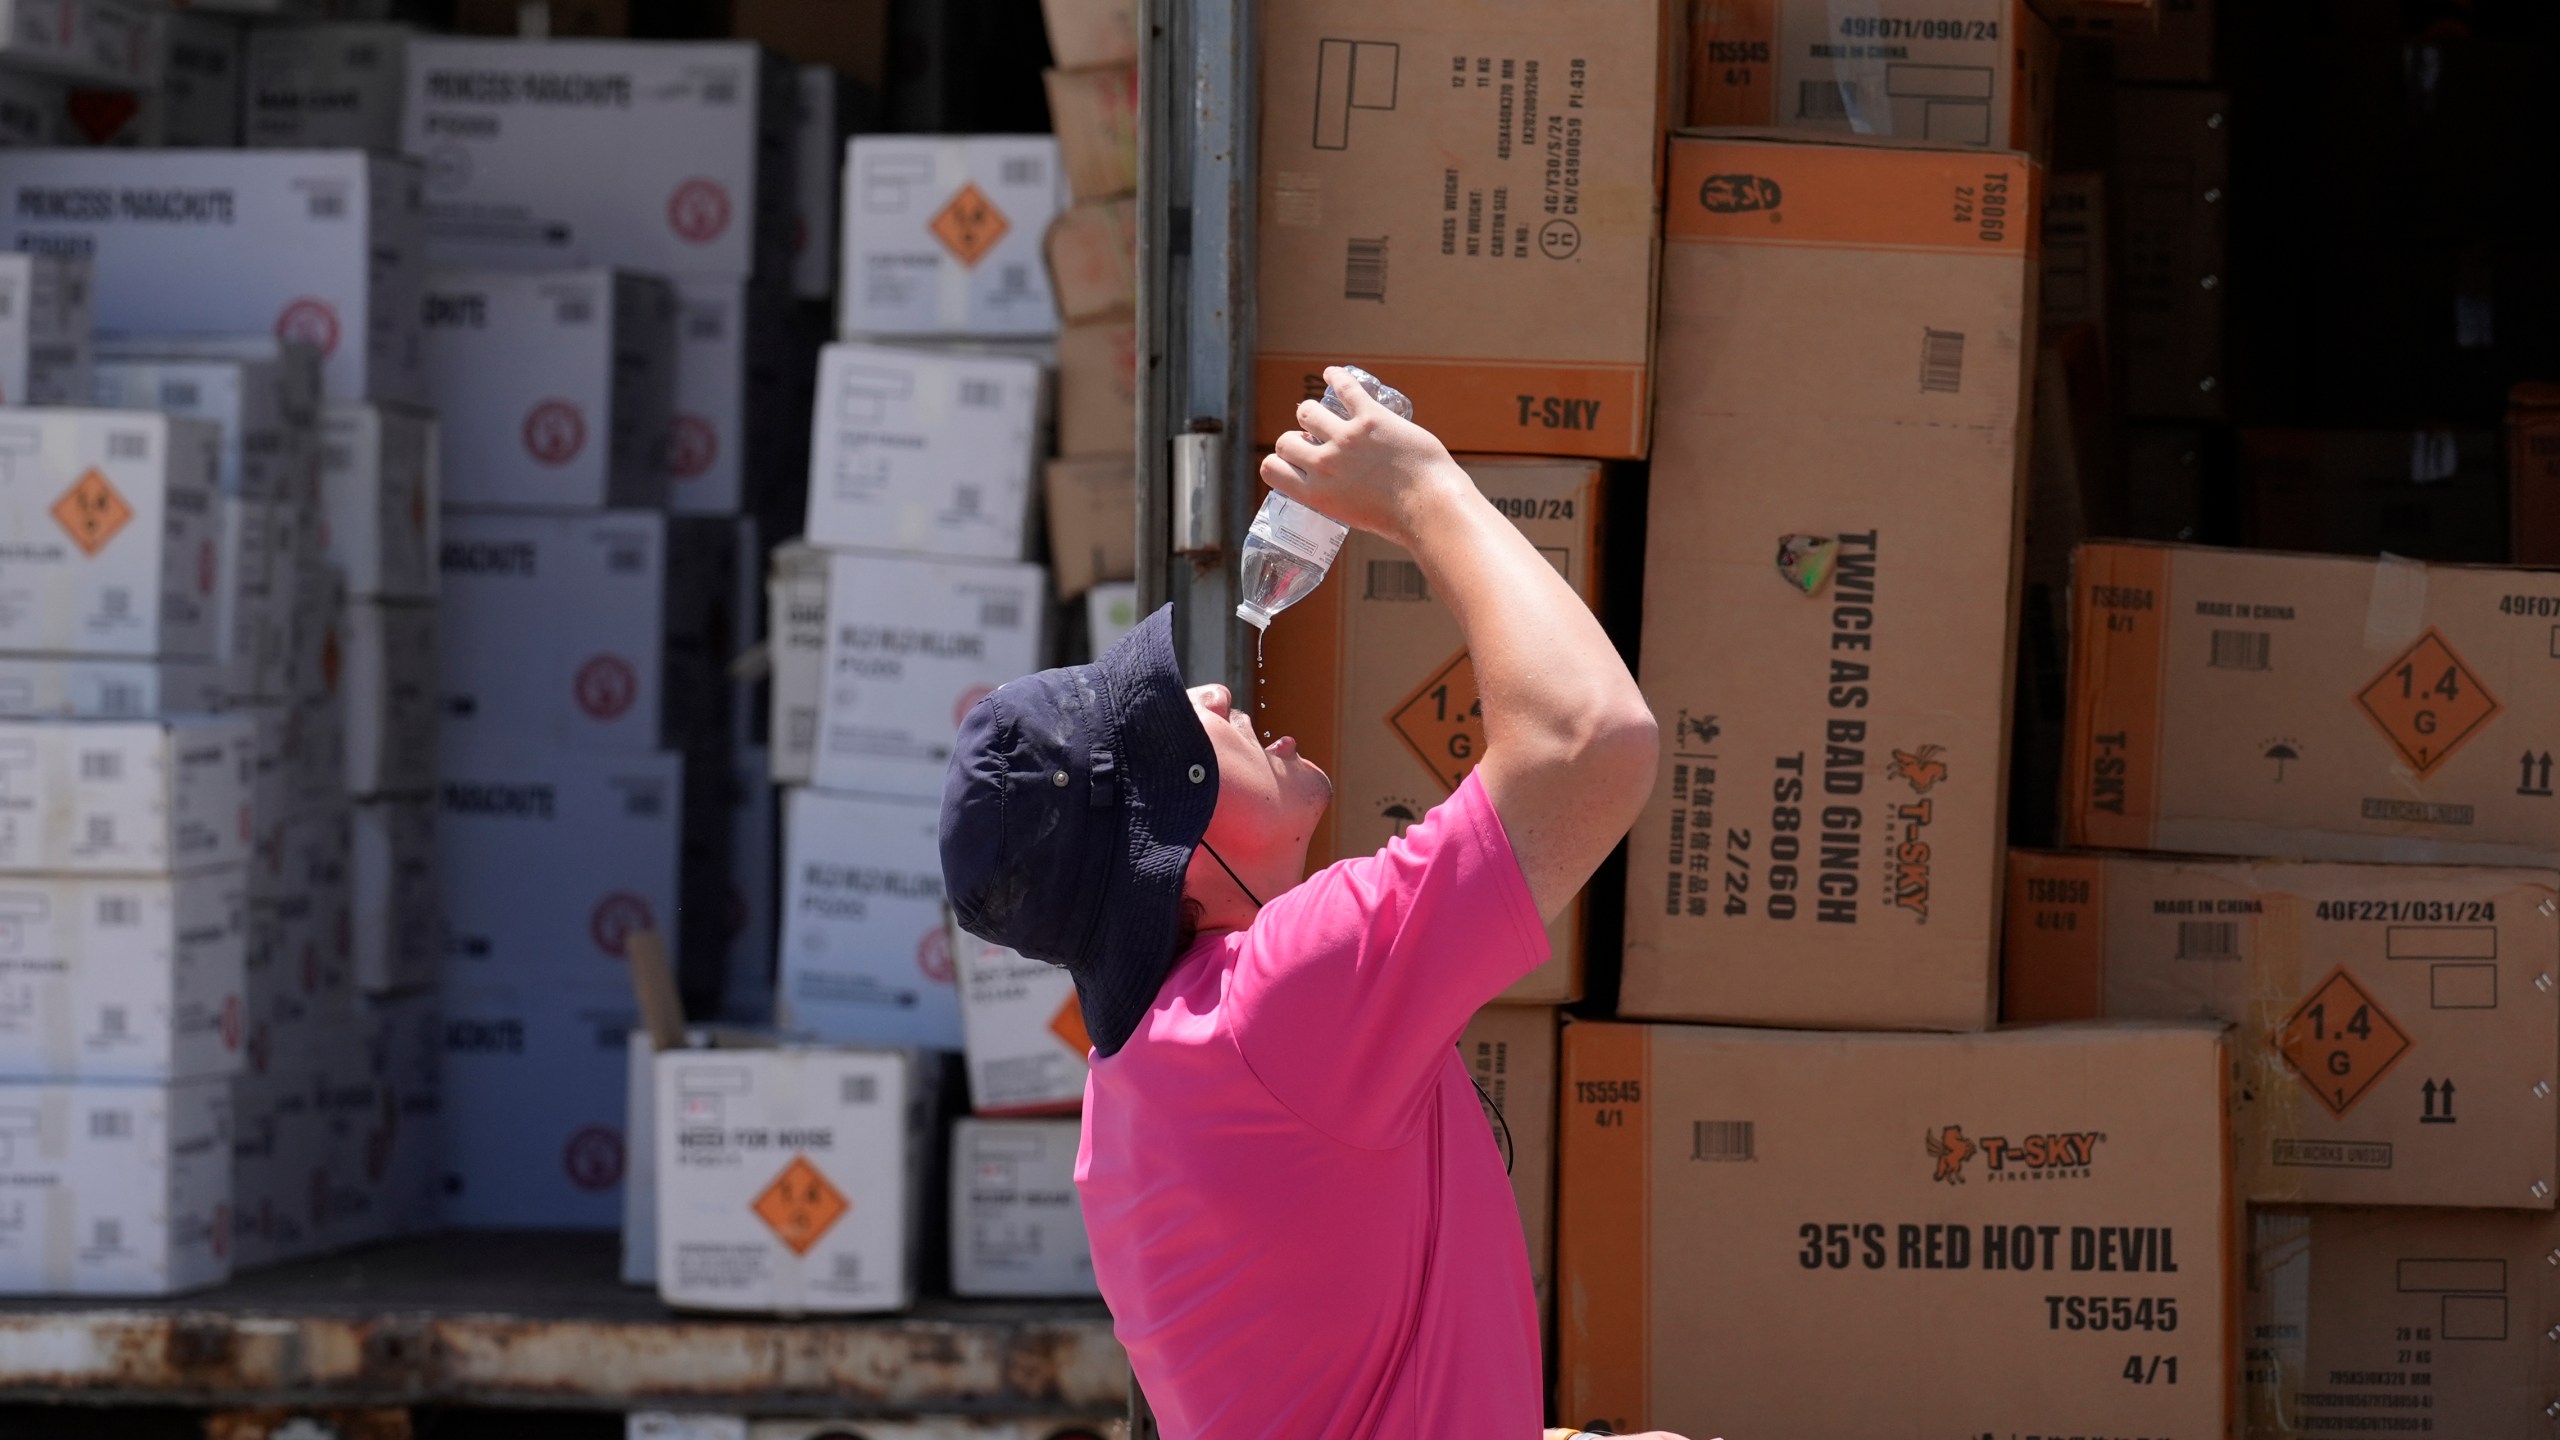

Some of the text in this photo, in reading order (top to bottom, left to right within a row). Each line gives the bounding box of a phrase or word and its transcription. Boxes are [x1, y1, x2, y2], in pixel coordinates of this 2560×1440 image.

[1709, 42, 1770, 64] TS5545
[1810, 44, 1909, 60] MADE IN CHINA
[1444, 168, 1459, 211] WEIGHT
[1953, 186, 1975, 223] 2/24
[1979, 172, 2009, 242] TS8060
[1442, 218, 1457, 255] GROSS
[1467, 236, 1480, 256] NET
[1491, 213, 1505, 258] CARTON
[1516, 395, 1601, 431] T-SKY
[2196, 601, 2296, 621] MADE IN CHINA
[2396, 663, 2459, 701] 1.4
[1817, 529, 1877, 924] TWICE AS BAD 6INCH
[2413, 710, 2436, 735] G
[1448, 733, 1471, 759] G
[2418, 747, 2430, 764] 1
[2094, 730, 2127, 815] T-SKY
[1666, 764, 1689, 917] MOST TRUSTED BRAND
[1767, 751, 1804, 921] TS8060
[1723, 827, 1752, 917] 2/24
[2154, 899, 2263, 914] MADE IN CHINA
[2316, 901, 2496, 922] 40F221/031/24
[2306, 1003, 2372, 1041] 1.4
[2327, 1050, 2351, 1077] G
[1574, 1080, 1641, 1104] TS5545
[2334, 1087, 2345, 1107] 1
[1595, 1109, 1625, 1128] 4/1
[1987, 1167, 2092, 1183] FIREWORKS
[1799, 1222, 2178, 1273] 35'S RED HOT DEVIL
[2045, 1294, 2178, 1332] TS5545
[2122, 1355, 2178, 1386] 4/1
